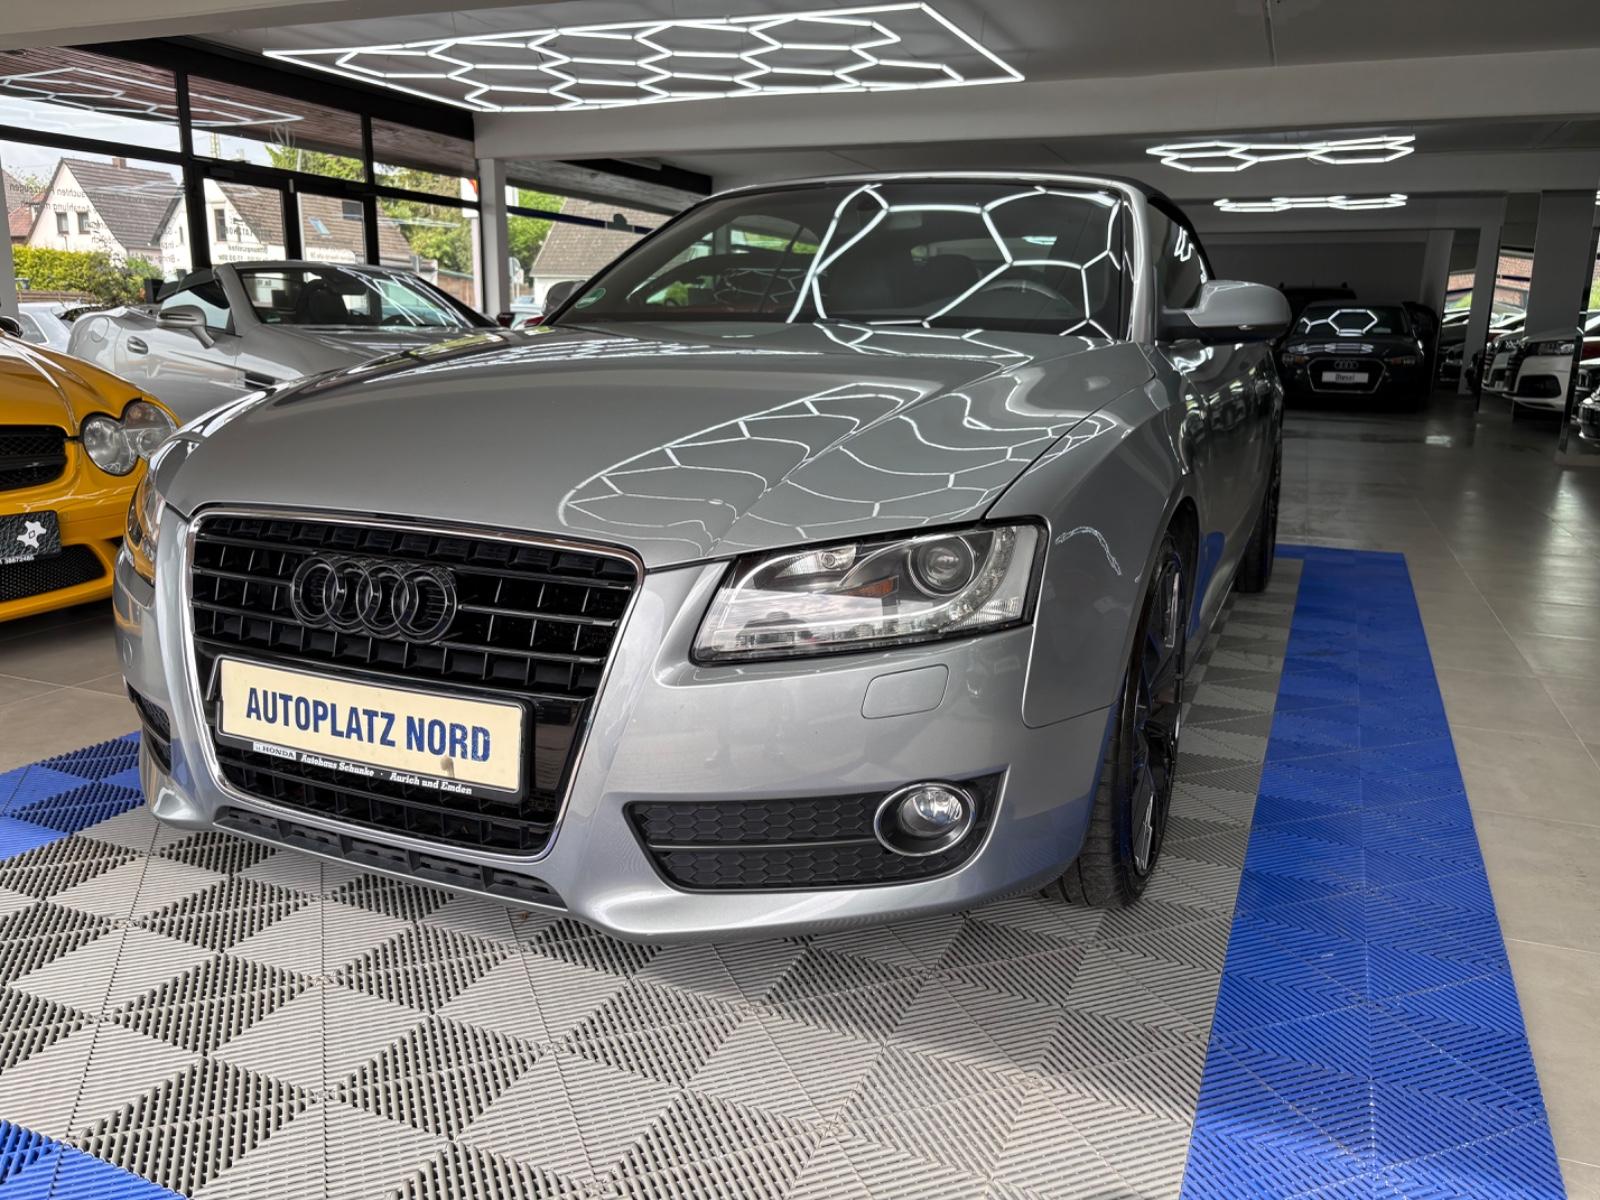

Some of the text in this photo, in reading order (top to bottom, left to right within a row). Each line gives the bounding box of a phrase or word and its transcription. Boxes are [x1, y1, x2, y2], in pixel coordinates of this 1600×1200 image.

[1335, 373, 1355, 382] Diesel
[246, 687, 491, 762] AUTOPLATZ NORD
[262, 745, 473, 795] HONDA Autohaus Schunke Aurich und Emden
